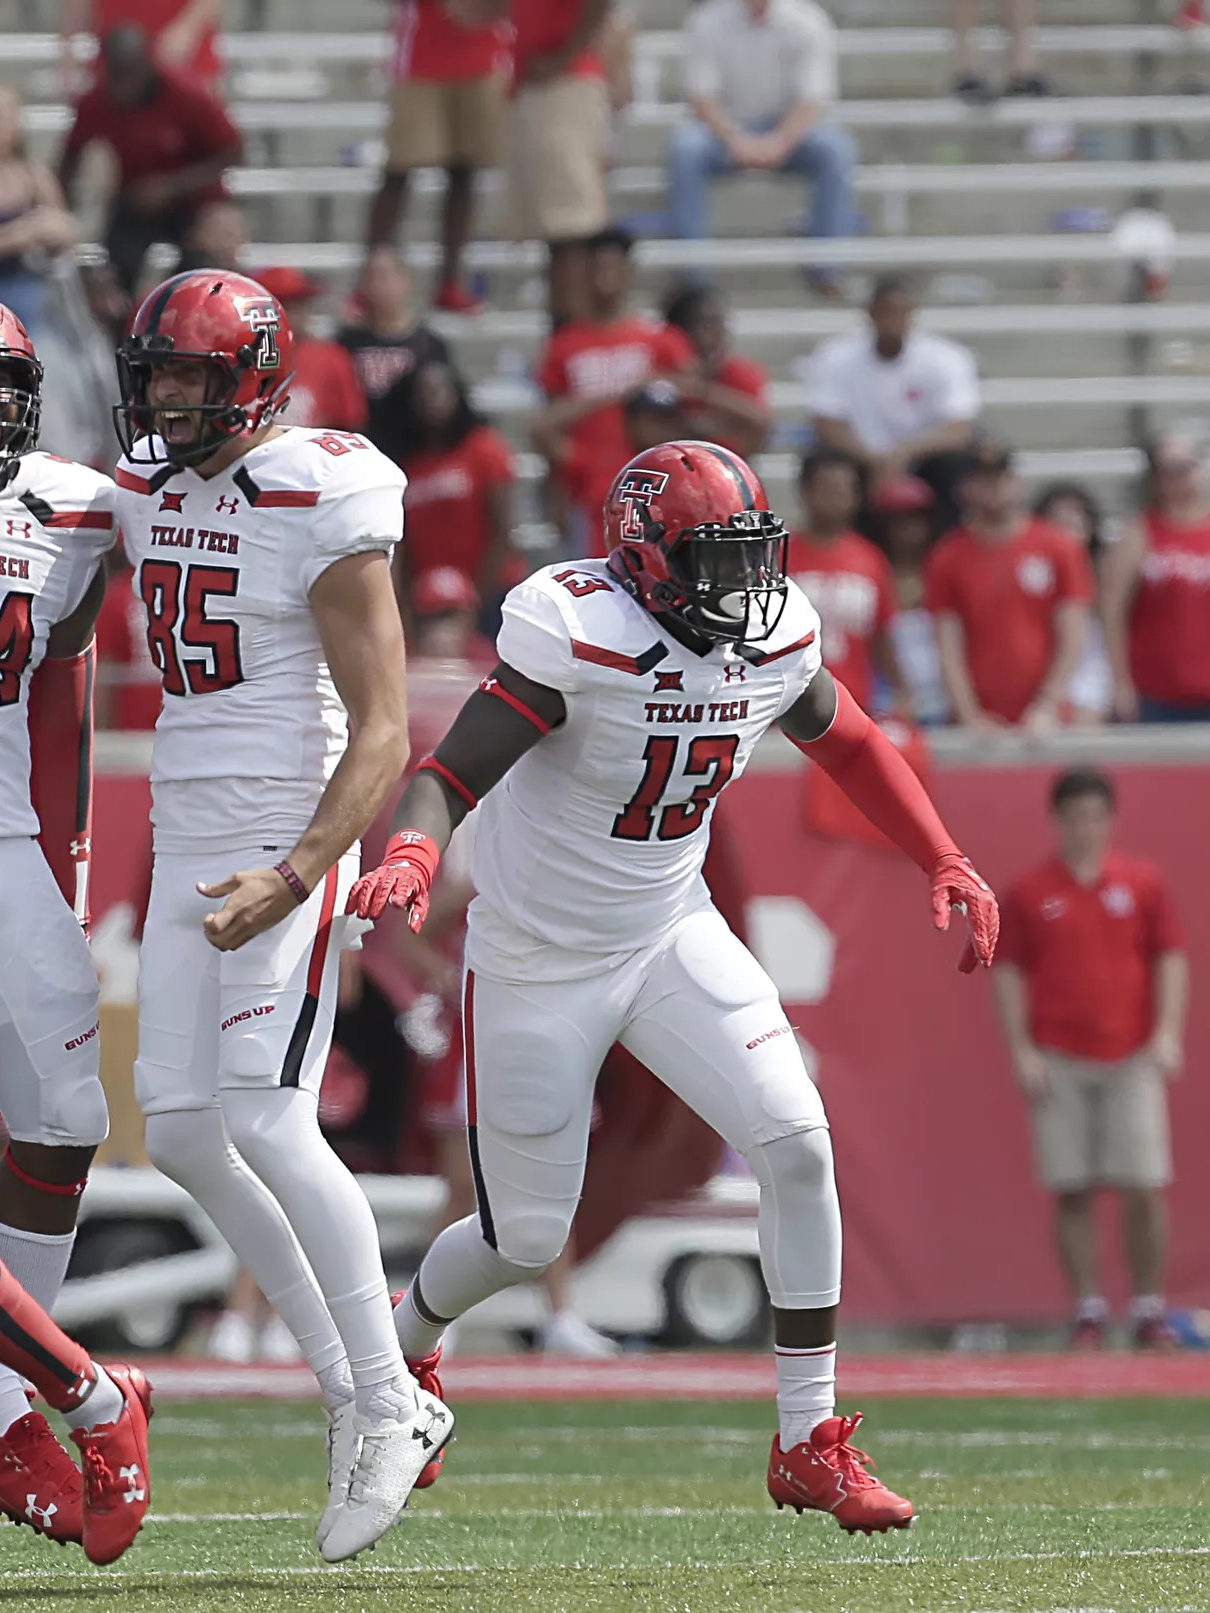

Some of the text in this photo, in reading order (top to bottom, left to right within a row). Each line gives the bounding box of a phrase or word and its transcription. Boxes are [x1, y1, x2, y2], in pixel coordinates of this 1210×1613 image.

[151, 526, 240, 554] TEXAS TECH
[551, 569, 615, 598] 13
[140, 558, 245, 697] 85
[645, 700, 750, 723] TEXAS TECH
[610, 734, 740, 842] 13
[221, 1005, 275, 1031] GUNS UP
[64, 1025, 97, 1051] GUNS
[746, 1028, 781, 1050] GUNS
